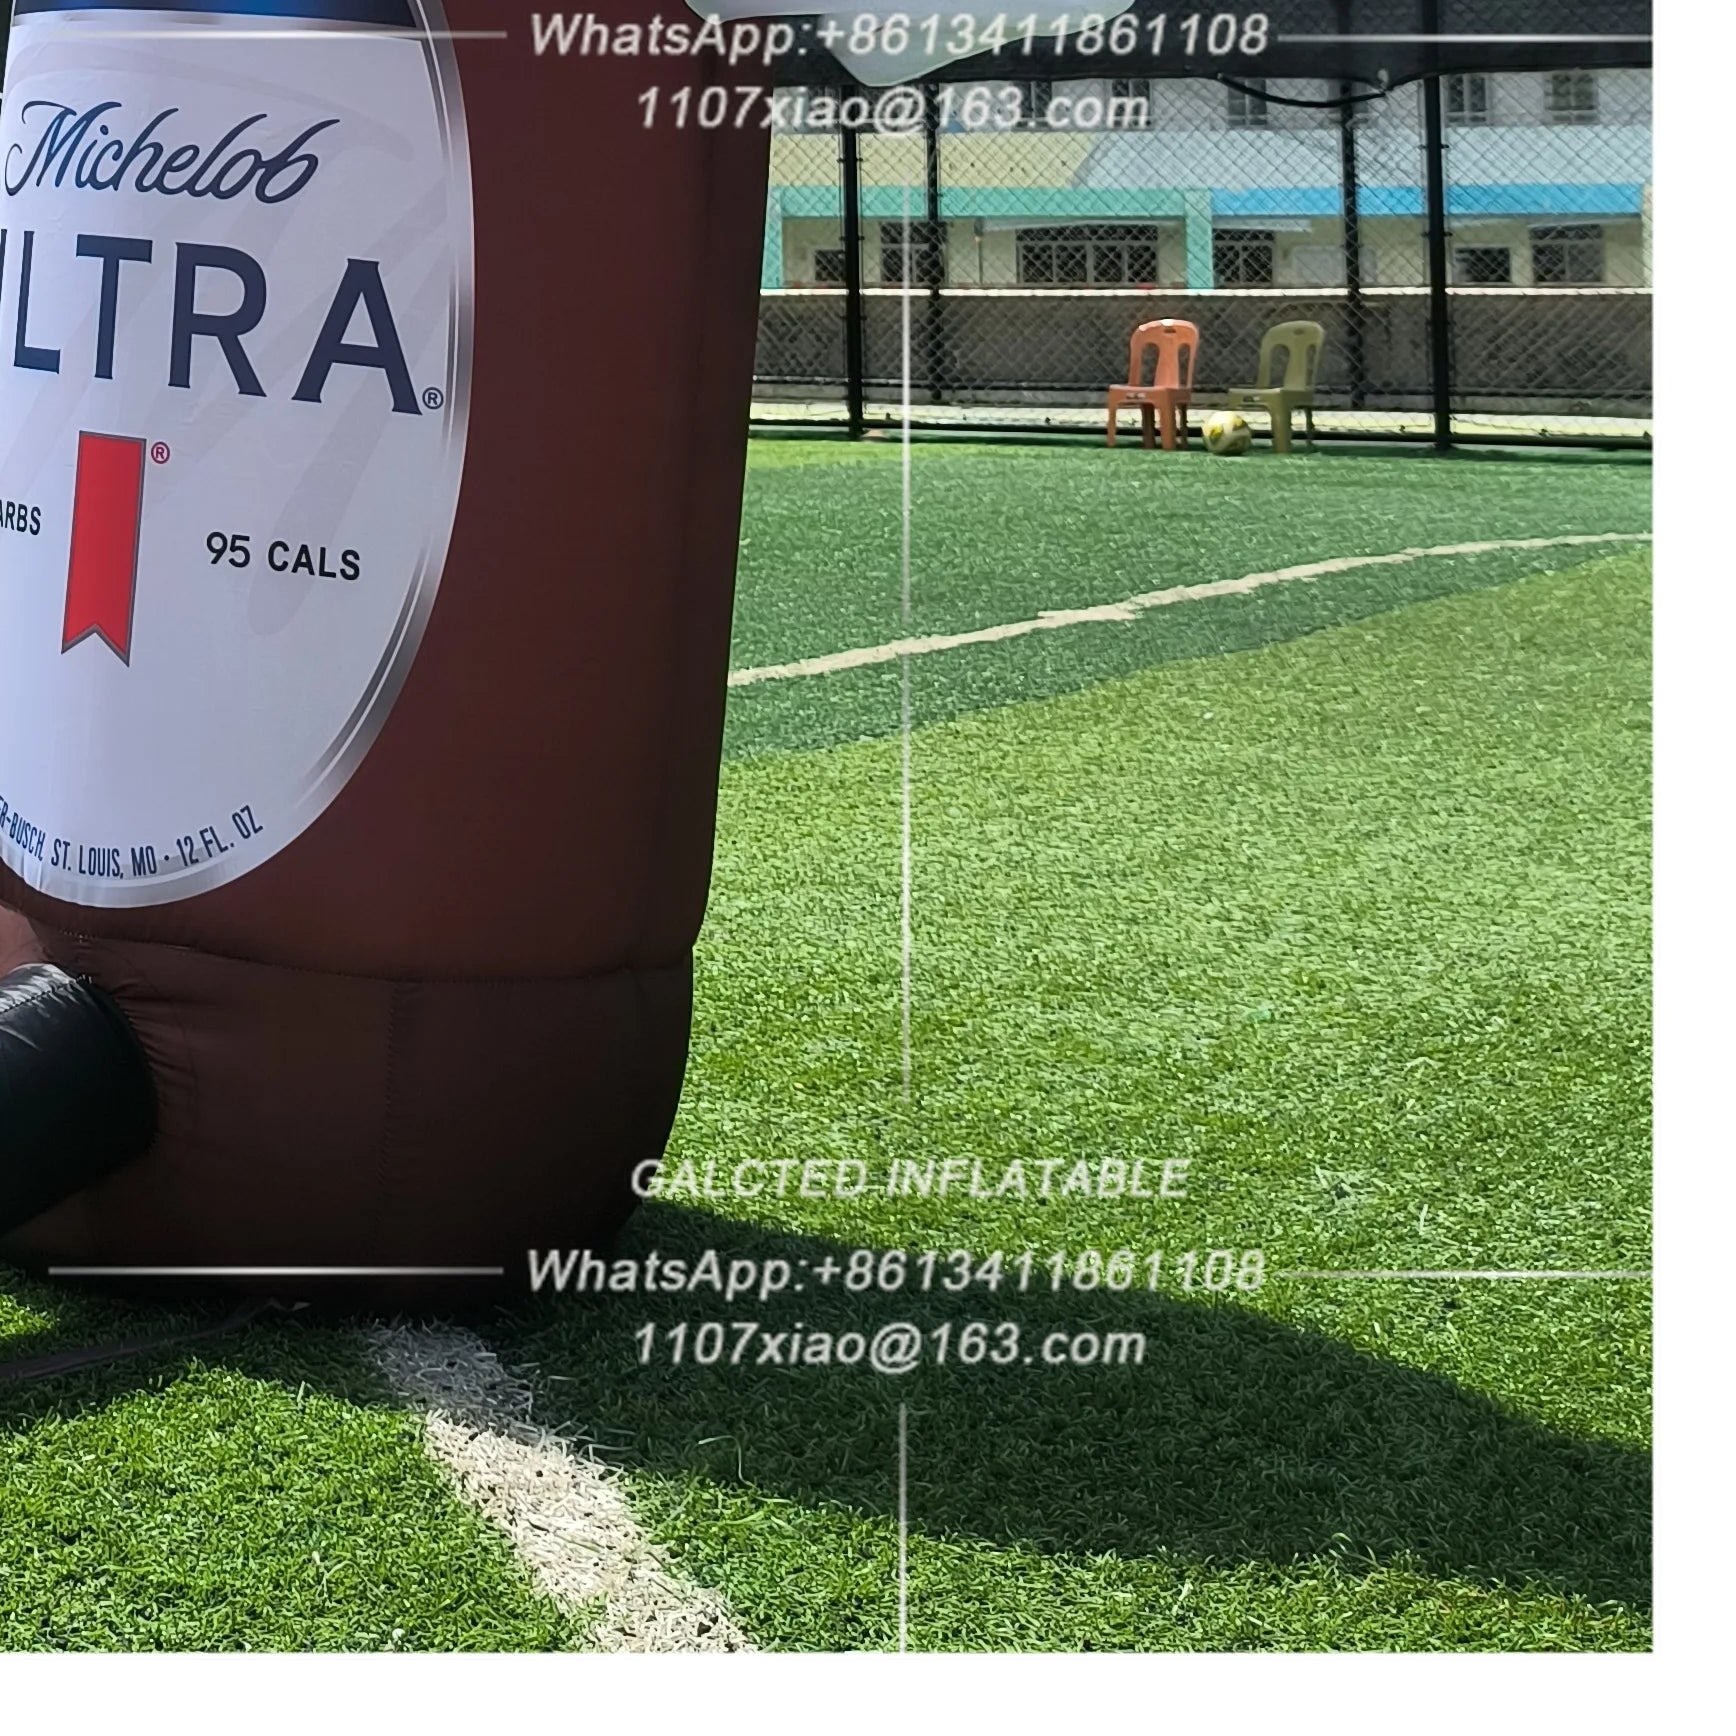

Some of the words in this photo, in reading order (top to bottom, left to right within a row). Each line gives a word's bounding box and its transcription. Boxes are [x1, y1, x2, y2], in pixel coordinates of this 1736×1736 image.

[5, 100, 341, 204] Michelob
[206, 531, 251, 568] 95
[267, 540, 361, 581] CALS
[51, 838, 72, 871] ST.
[78, 844, 124, 879] LOUIS,
[131, 845, 157, 876] MO
[176, 836, 199, 867] 12
[199, 826, 234, 858] FL.
[231, 804, 264, 840] OZ
